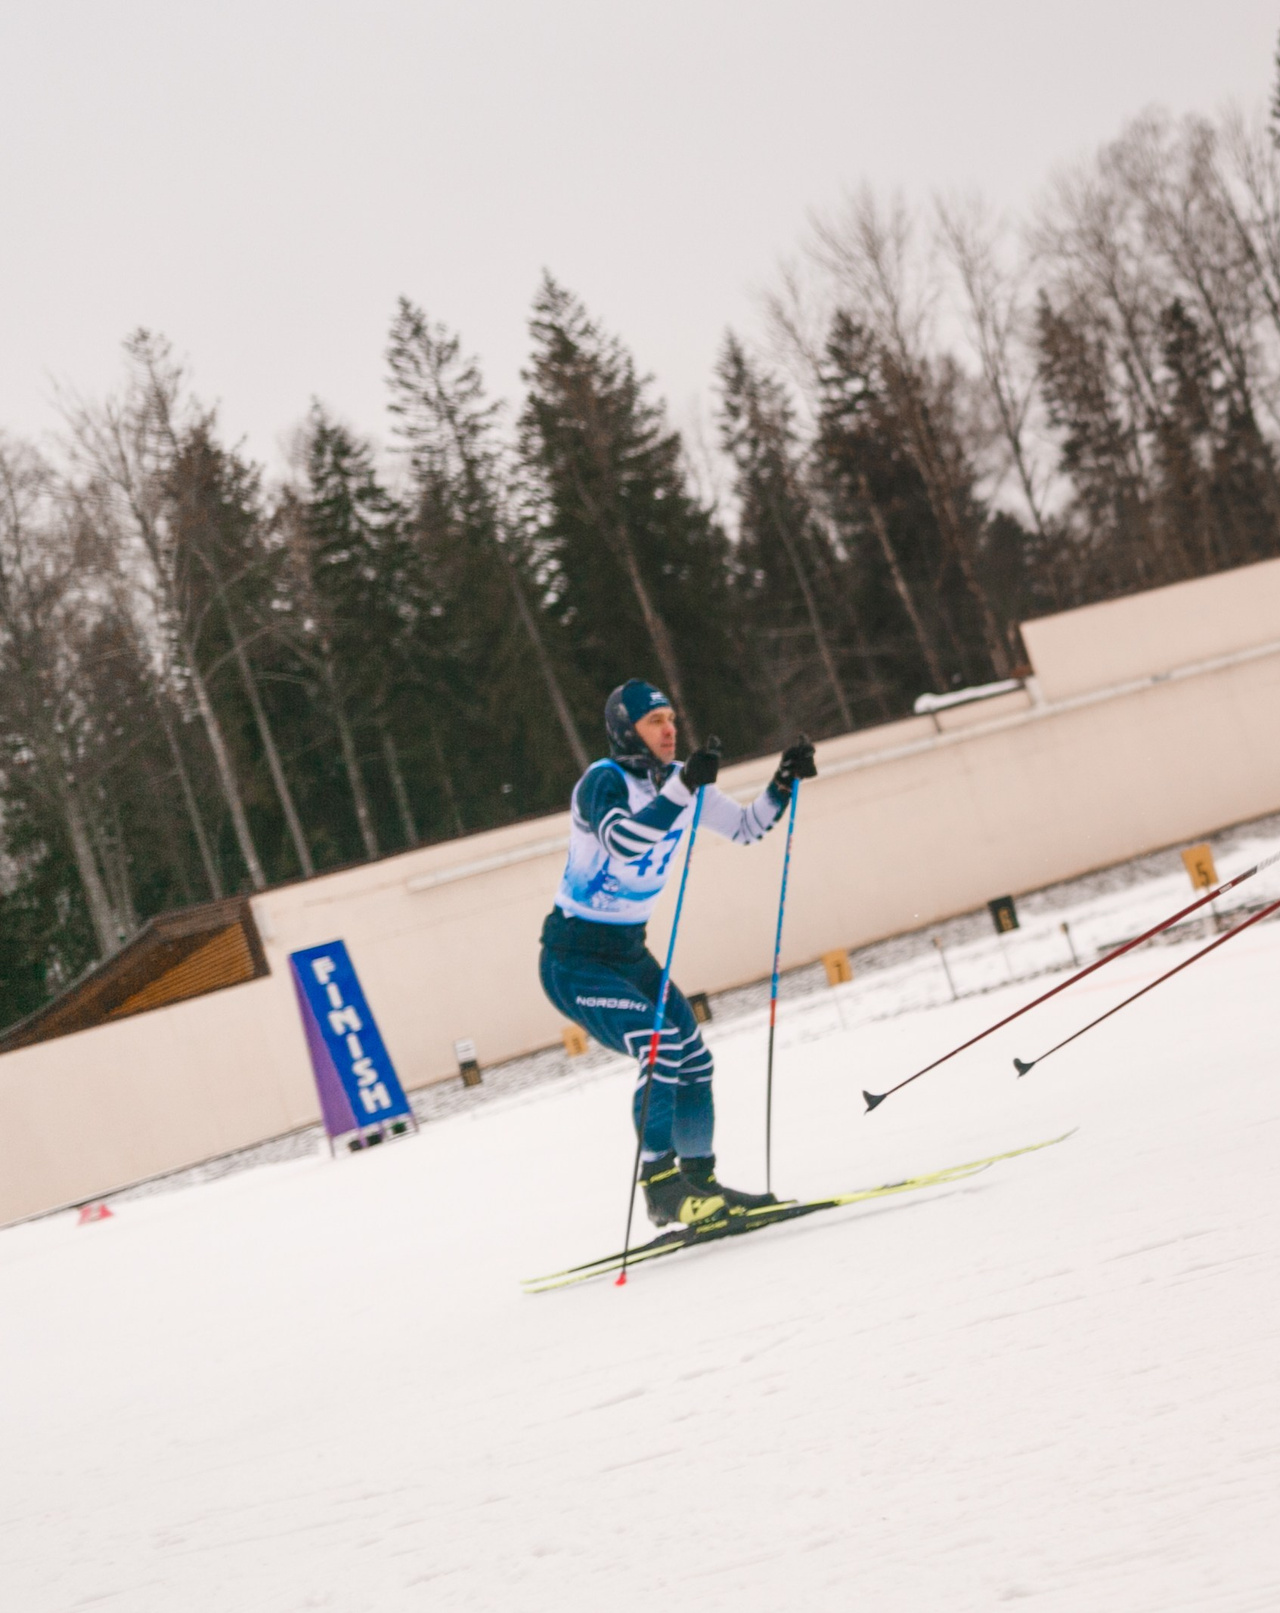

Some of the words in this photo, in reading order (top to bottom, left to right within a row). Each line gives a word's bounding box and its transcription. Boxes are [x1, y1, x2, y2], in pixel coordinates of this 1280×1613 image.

[1195, 861, 1210, 887] 5
[575, 995, 648, 1013] NORDSKI
[310, 955, 393, 1114] FINISH
